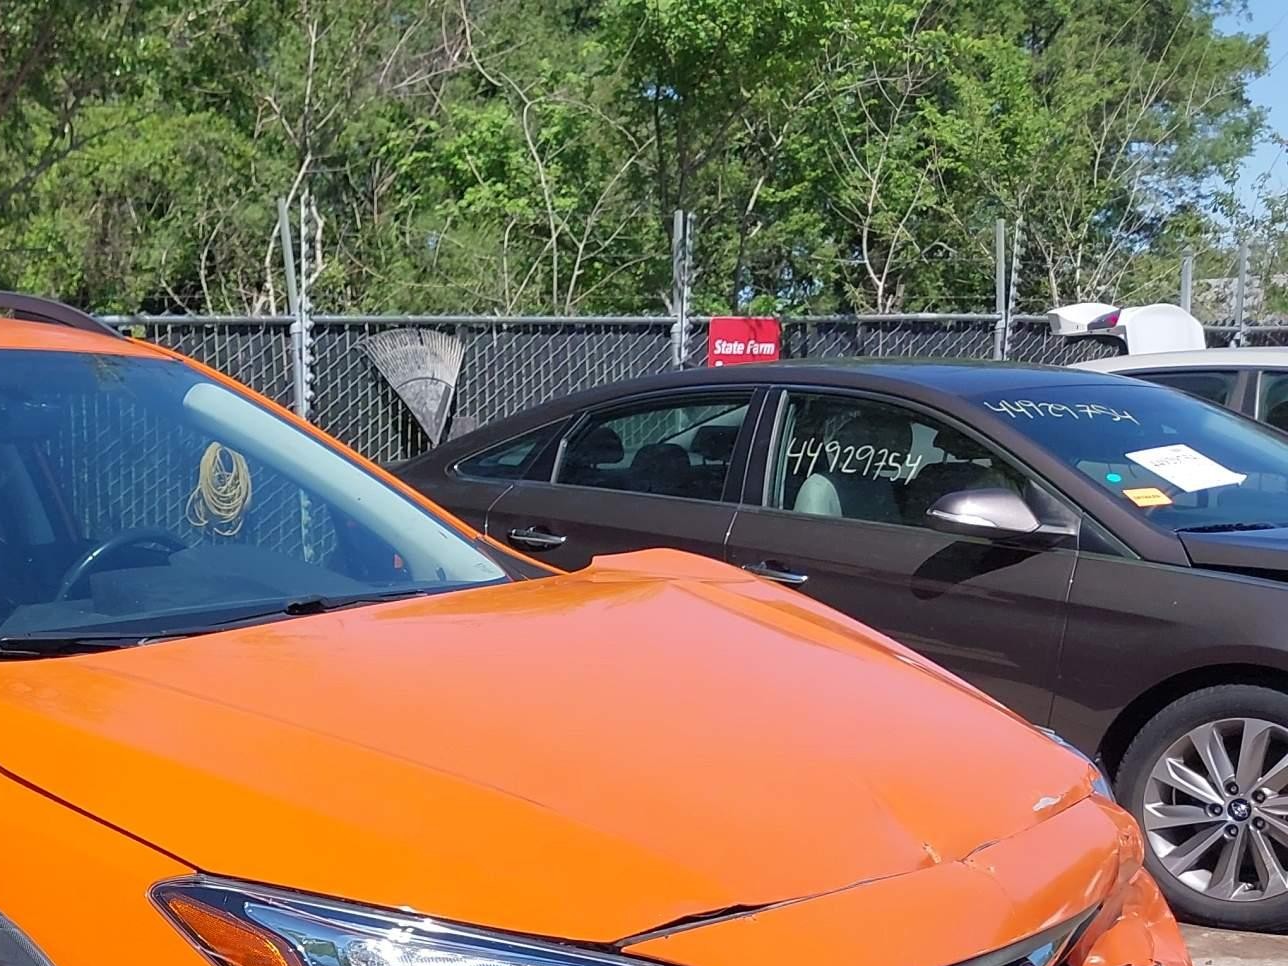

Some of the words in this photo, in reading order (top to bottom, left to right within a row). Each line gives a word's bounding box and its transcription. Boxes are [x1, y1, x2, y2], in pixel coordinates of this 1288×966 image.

[714, 340, 745, 355] State
[746, 340, 775, 354] Farm
[786, 436, 923, 486] 44929754
